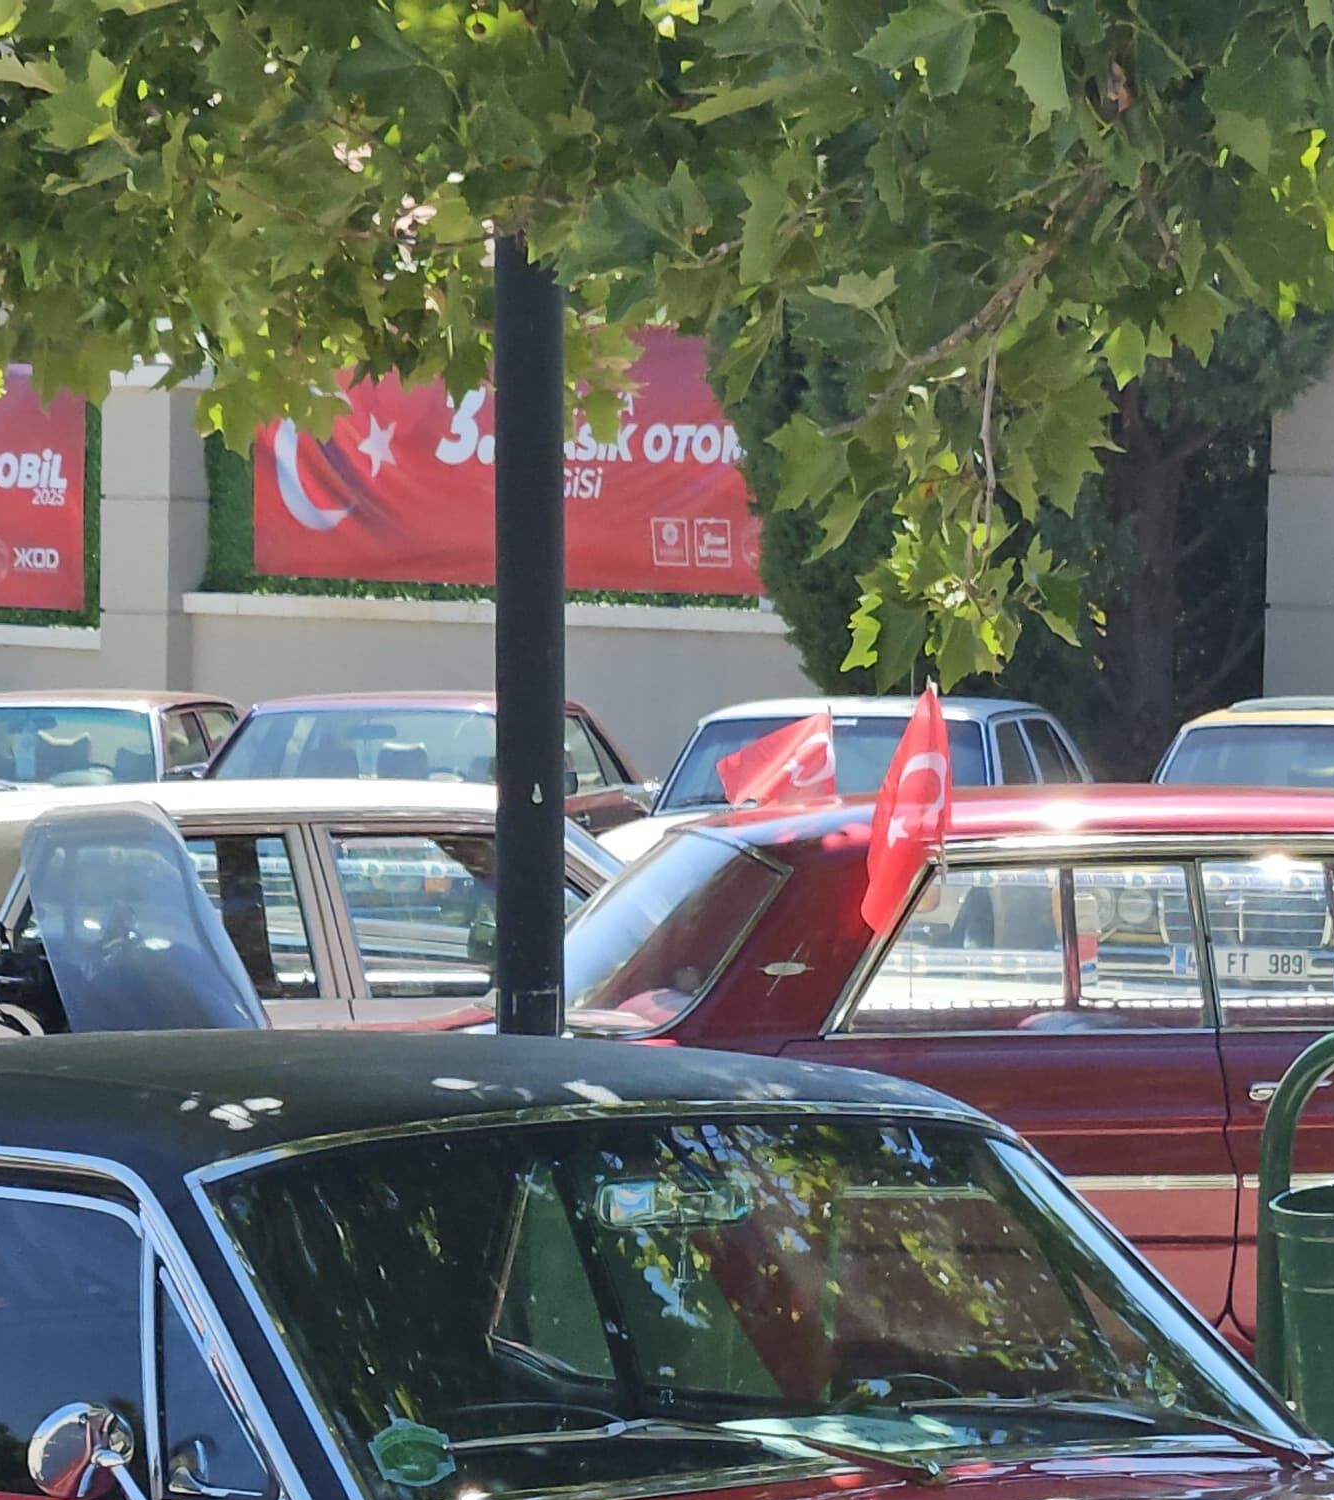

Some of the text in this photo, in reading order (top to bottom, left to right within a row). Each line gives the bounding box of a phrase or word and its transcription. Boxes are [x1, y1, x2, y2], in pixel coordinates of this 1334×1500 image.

[32, 489, 65, 506] 2025
[1227, 953, 1249, 972] FT
[1268, 954, 1303, 974] 989
